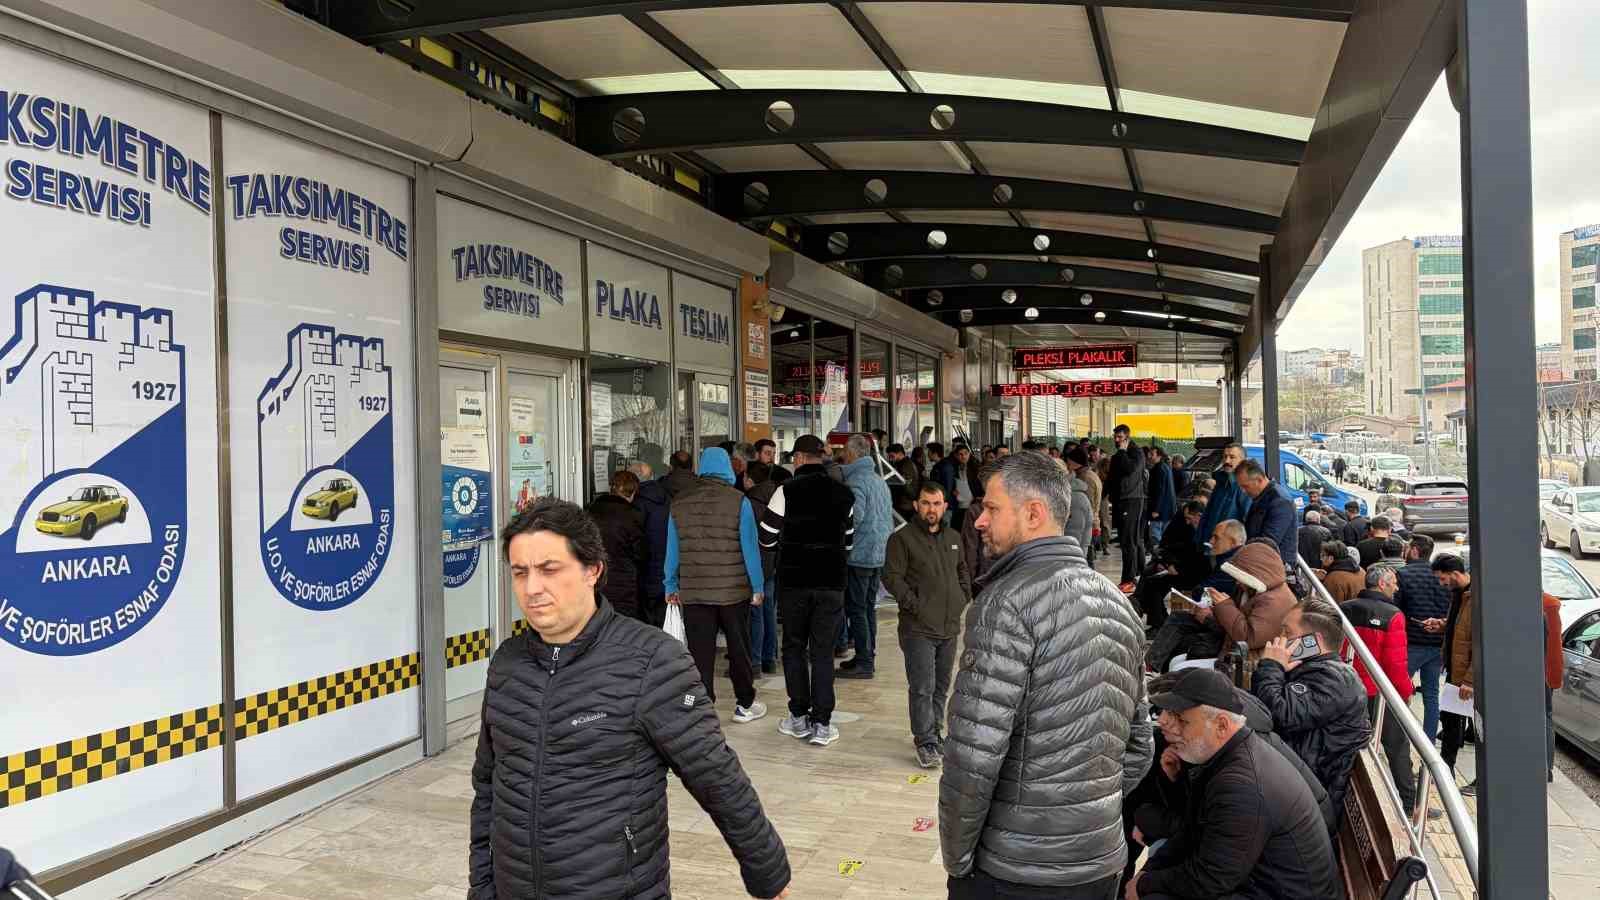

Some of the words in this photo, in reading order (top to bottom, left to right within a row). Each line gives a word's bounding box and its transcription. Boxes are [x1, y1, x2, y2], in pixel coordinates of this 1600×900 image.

[596, 279, 662, 329] PLAKA
[131, 381, 176, 402] 1927
[358, 396, 386, 411] 1927
[279, 565, 296, 592] VE
[294, 580, 351, 602] ŞOFÖRLER
[350, 552, 379, 592] ESNAF
[375, 508, 391, 556] ODASI
[306, 532, 361, 555] ANKARA
[41, 554, 131, 583] ANKARA
[20, 614, 114, 645] ŞOFÖRLER
[114, 579, 160, 631] ESNAF
[156, 524, 180, 583] ODASI
[579, 711, 608, 723] Columbia
